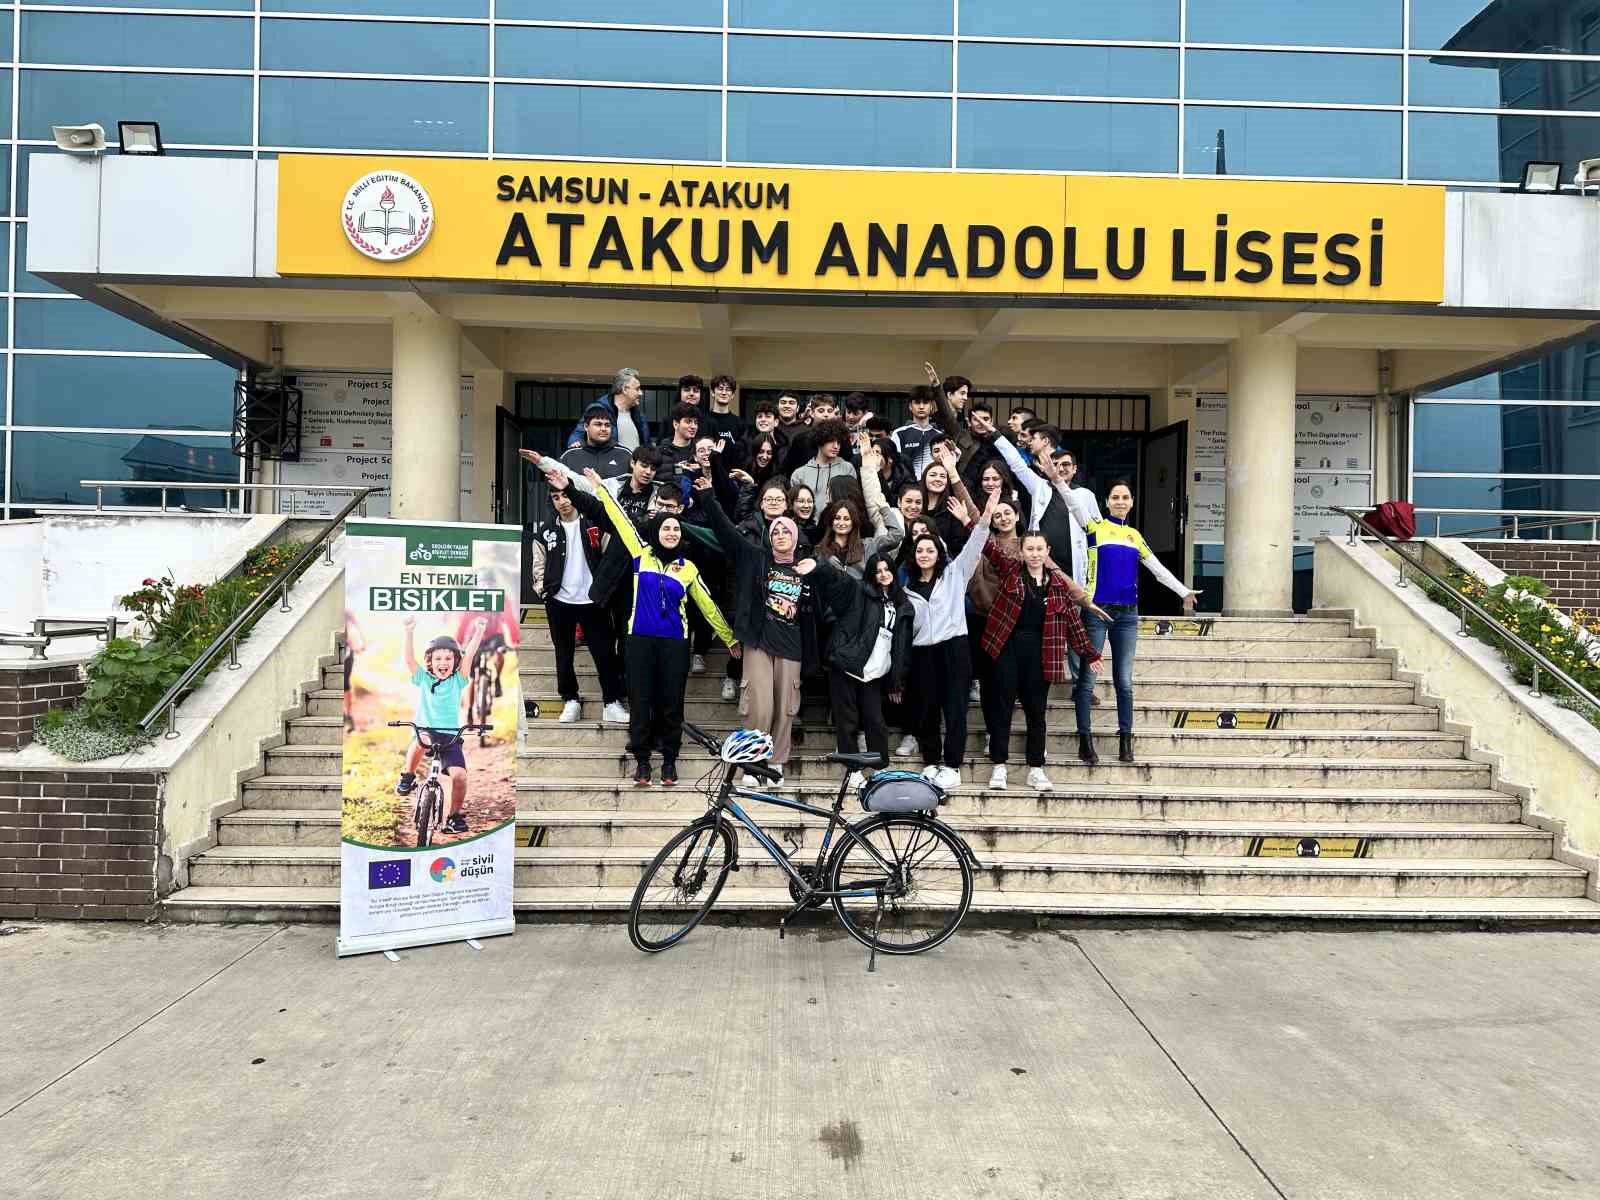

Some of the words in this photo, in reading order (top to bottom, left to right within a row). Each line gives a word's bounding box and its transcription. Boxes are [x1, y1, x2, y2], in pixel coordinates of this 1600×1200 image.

[496, 174, 629, 205] SAMSUN
[659, 180, 790, 210] ATAKUM
[495, 212, 789, 276] ATAKUM
[814, 222, 1146, 281] ANADOLU
[1171, 213, 1385, 287] LİSESİ
[348, 380, 379, 389] Project
[382, 380, 393, 389] Sc
[362, 399, 390, 407] Project
[1295, 402, 1310, 410] ool
[346, 455, 378, 465] Project
[381, 456, 392, 464] Sc
[361, 472, 389, 481] Project
[400, 572, 422, 585] EN
[472, 853, 494, 866] sivil
[460, 865, 494, 879] düşün
